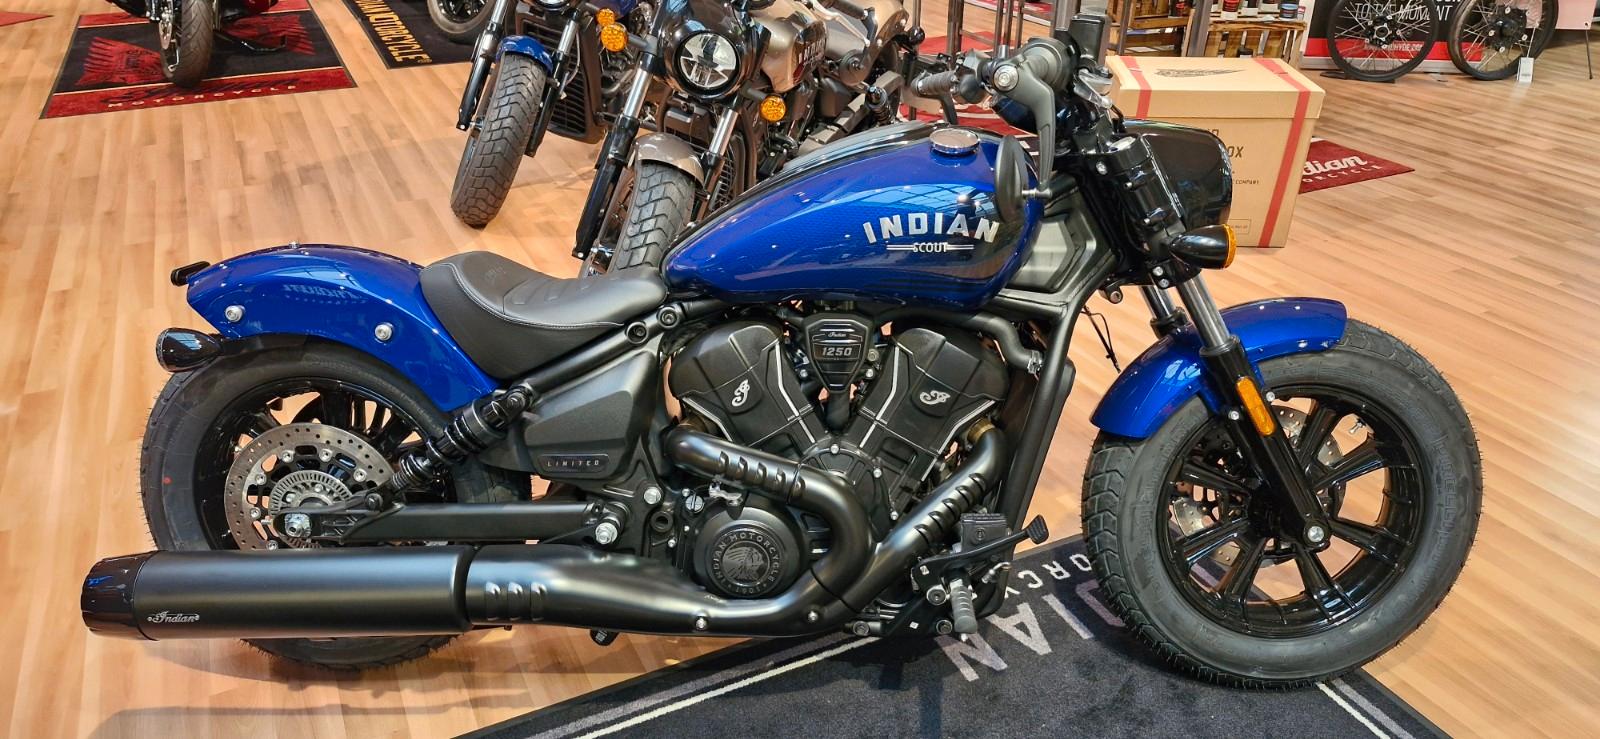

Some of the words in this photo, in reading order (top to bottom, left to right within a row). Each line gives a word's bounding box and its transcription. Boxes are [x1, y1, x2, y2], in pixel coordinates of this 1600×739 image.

[1227, 146, 1244, 158] OX
[1302, 155, 1368, 176] dian
[1302, 165, 1383, 183] ORCYCLE
[863, 212, 999, 244] INDIAN
[912, 242, 949, 253] SCOUT
[822, 347, 852, 356] 1250
[729, 532, 779, 582] MOTORCYCLE
[151, 610, 196, 624] Indian
